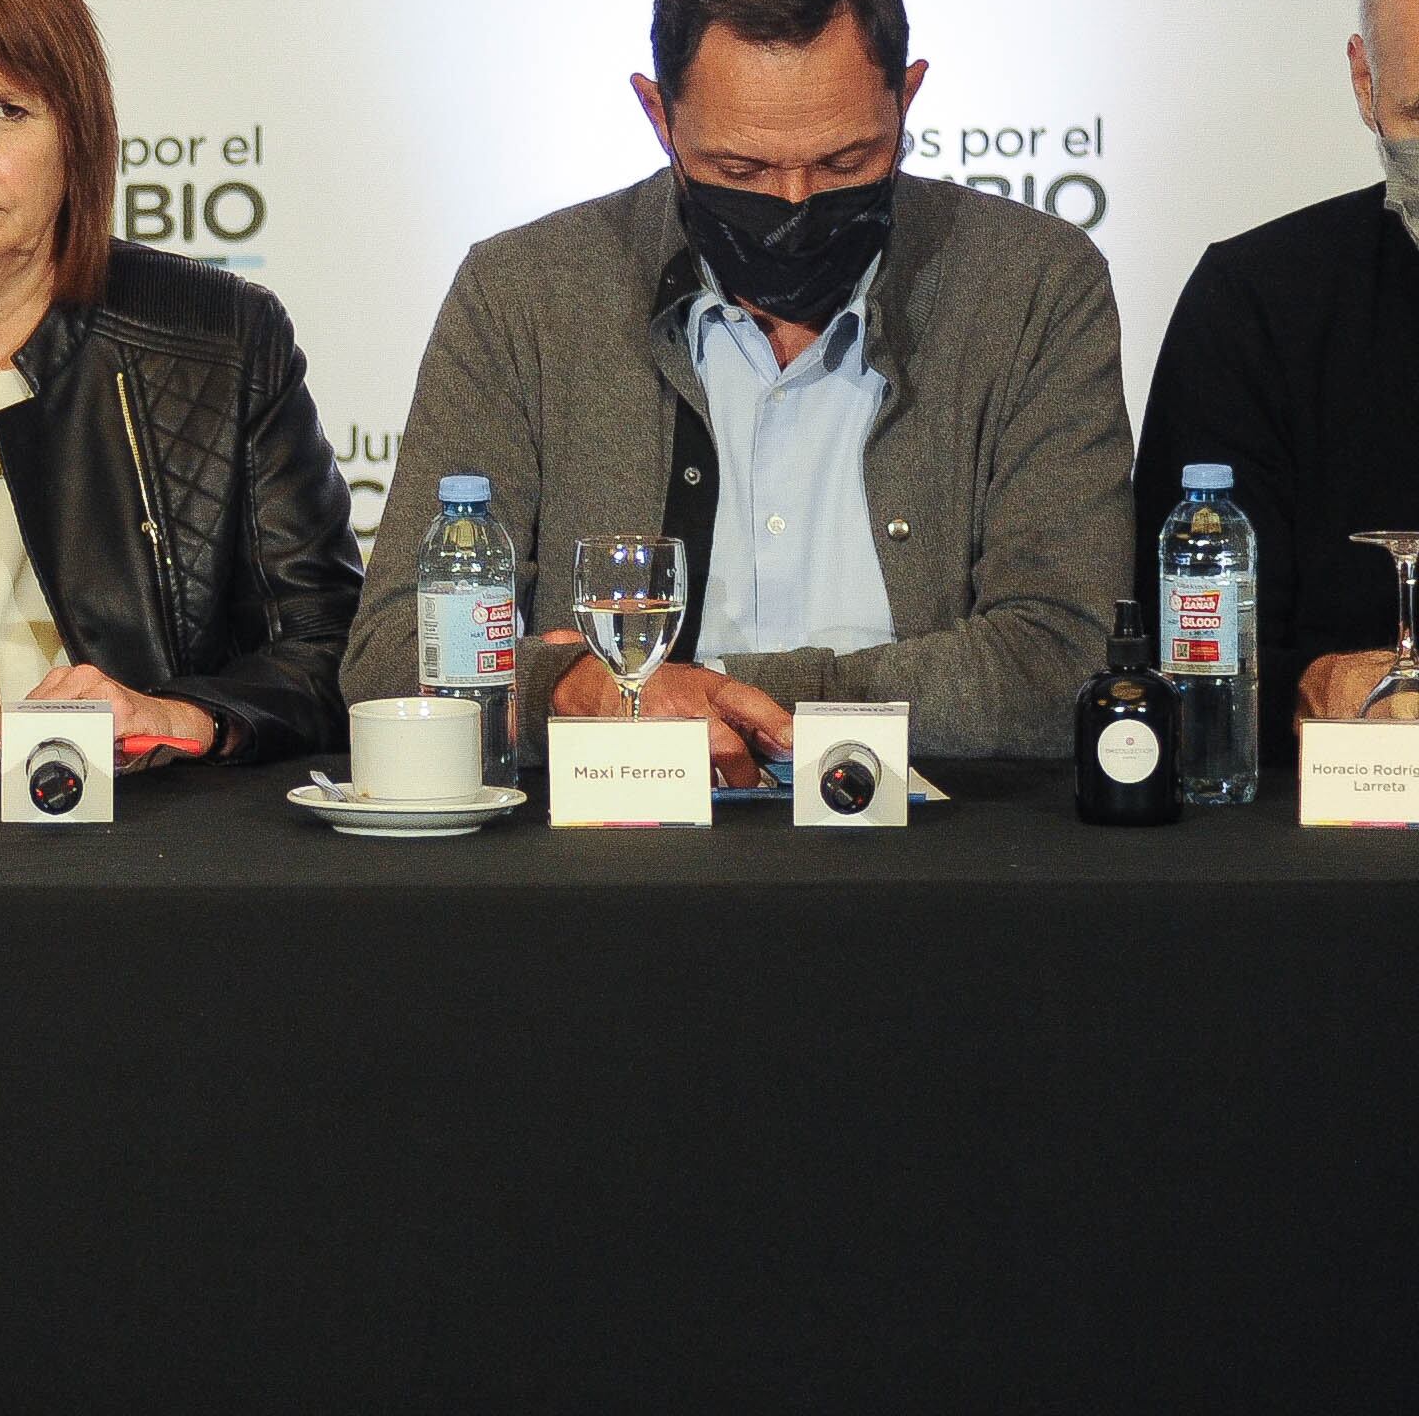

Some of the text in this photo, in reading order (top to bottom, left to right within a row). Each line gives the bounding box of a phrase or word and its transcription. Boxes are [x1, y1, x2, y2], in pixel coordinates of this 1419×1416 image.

[120, 123, 261, 176] por el
[961, 126, 1047, 166] por
[1063, 115, 1103, 158] el
[124, 182, 266, 242] BIO
[573, 765, 686, 780] Maxi Ferraro
[1312, 763, 1369, 776] Horacio
[1353, 780, 1406, 793] Larreta
